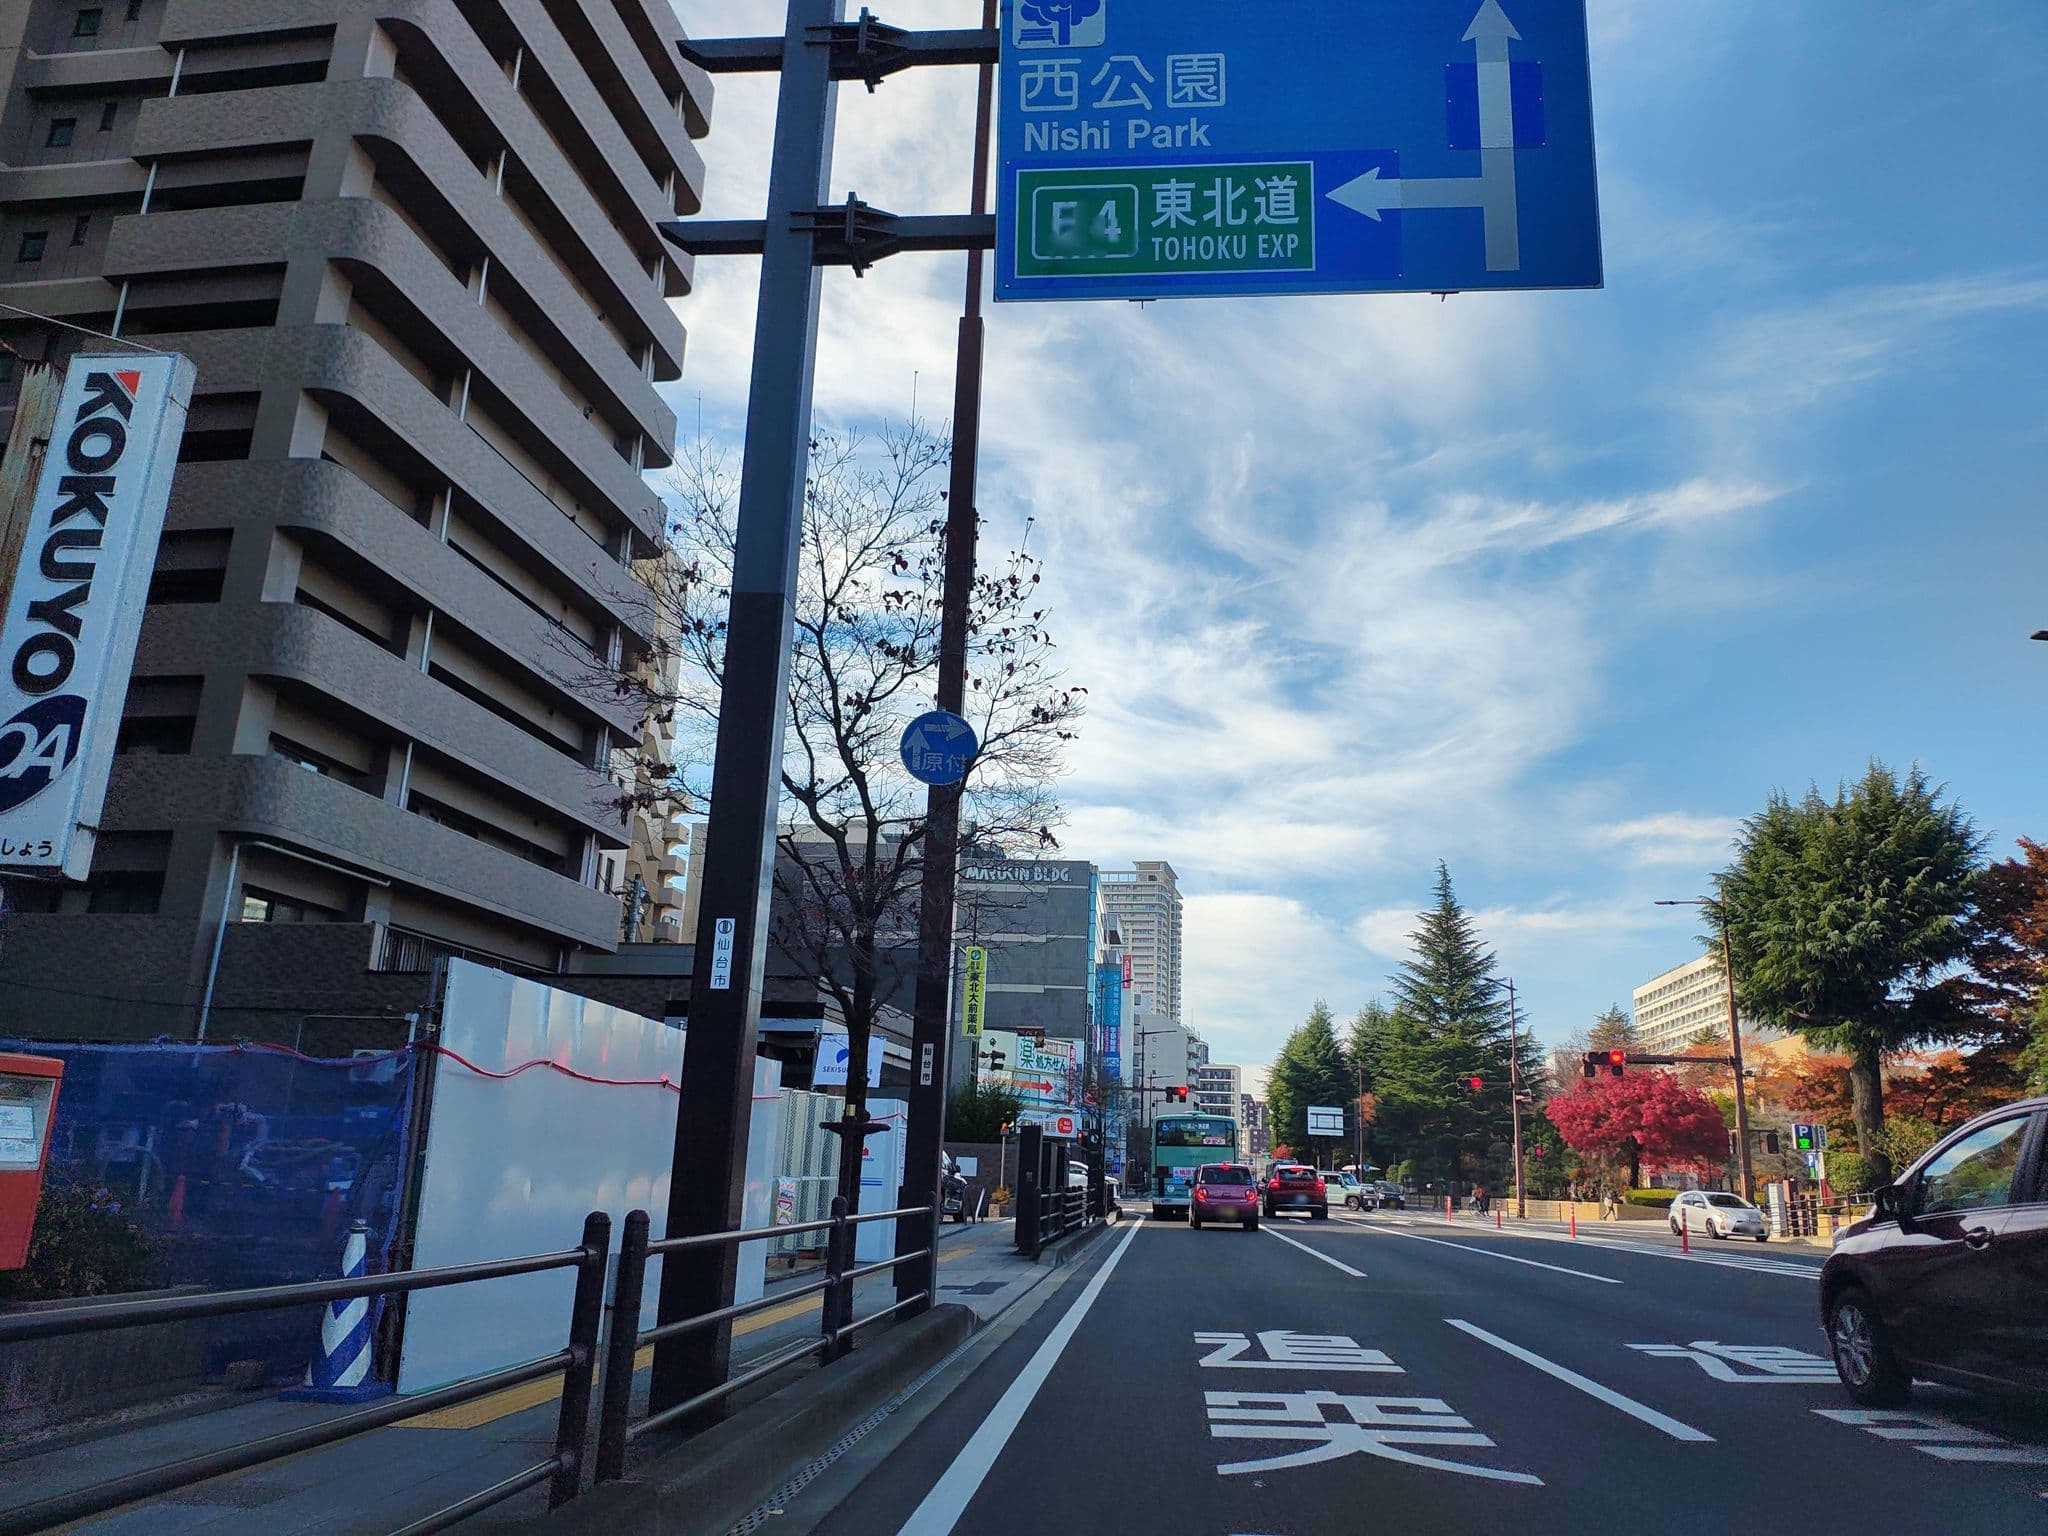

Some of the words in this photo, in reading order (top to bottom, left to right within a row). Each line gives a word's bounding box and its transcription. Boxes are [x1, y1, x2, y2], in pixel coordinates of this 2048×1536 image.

[1018, 53, 1227, 112] 西公園
[1023, 120, 1112, 153] Nishi
[1127, 117, 1212, 150] Park
[1151, 175, 1300, 229] 東北道
[1151, 235, 1247, 262] TOHOKU
[1257, 233, 1299, 259] EXP
[11, 371, 141, 697] KOKUYO
[713, 938, 730, 988] 仙台市
[967, 972, 981, 1036] 東北大前薬局
[1036, 1054, 1068, 1074] 処方せん
[1799, 1126, 1809, 1137] P
